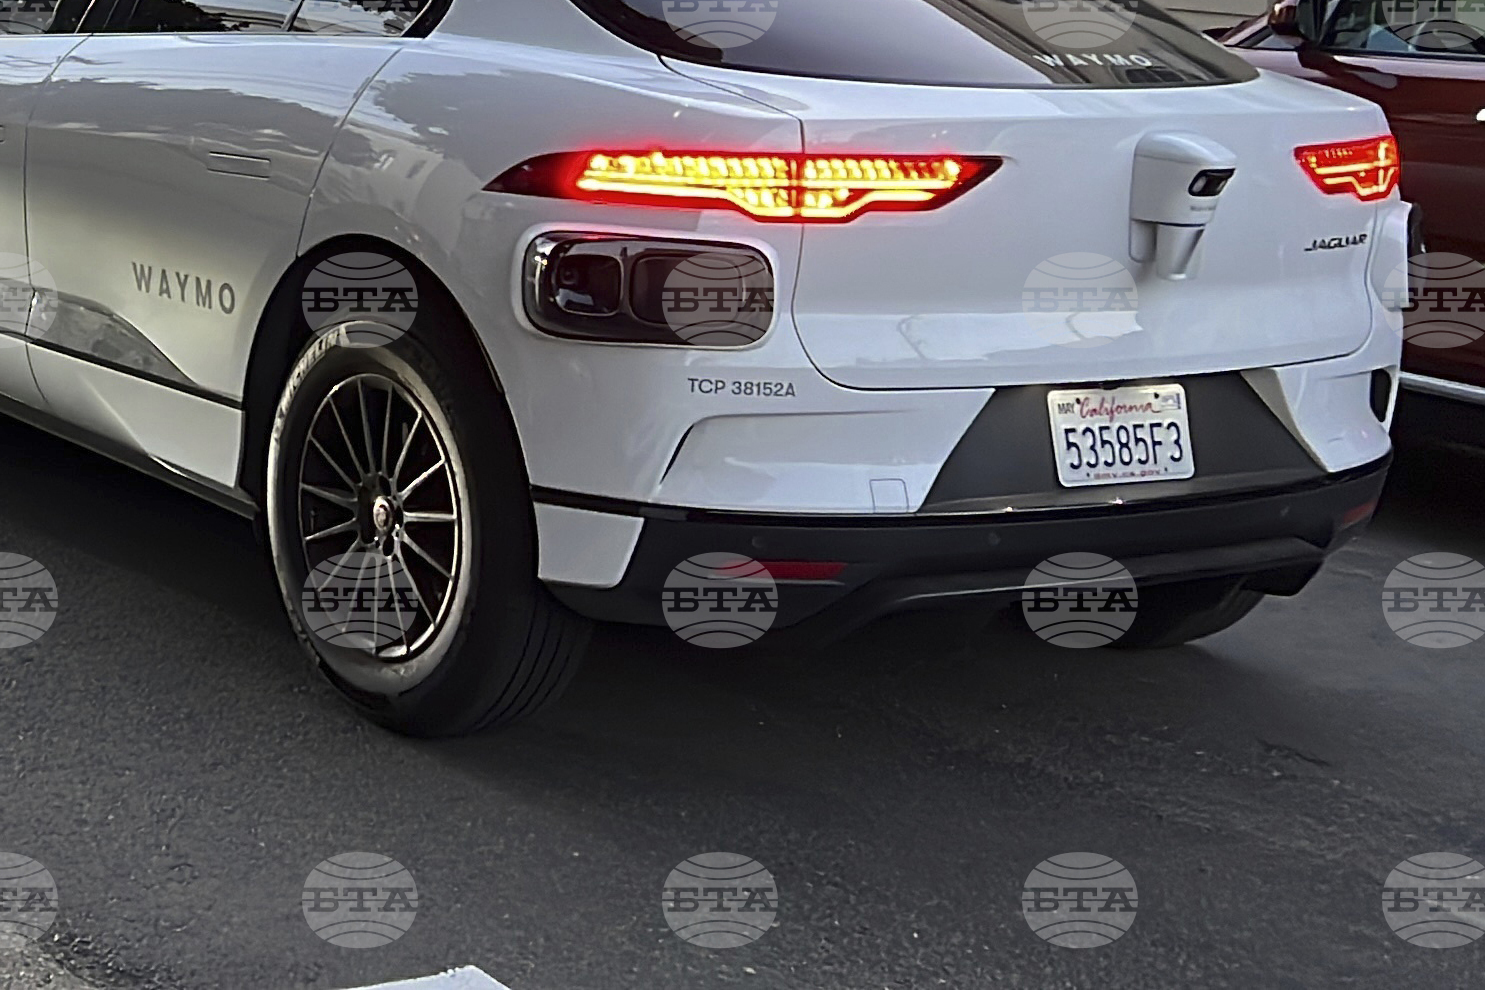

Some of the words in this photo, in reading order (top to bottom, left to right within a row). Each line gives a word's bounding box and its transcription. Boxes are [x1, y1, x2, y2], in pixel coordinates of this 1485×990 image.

[1032, 53, 1153, 67] WAYMO
[1303, 234, 1368, 251] JAGUAR
[131, 261, 236, 315] WAYMO
[687, 378, 726, 394] TCP
[731, 381, 796, 397] 38152A
[1057, 402, 1075, 414] MAY
[1079, 396, 1163, 422] California
[1064, 421, 1183, 469] 53585F3
